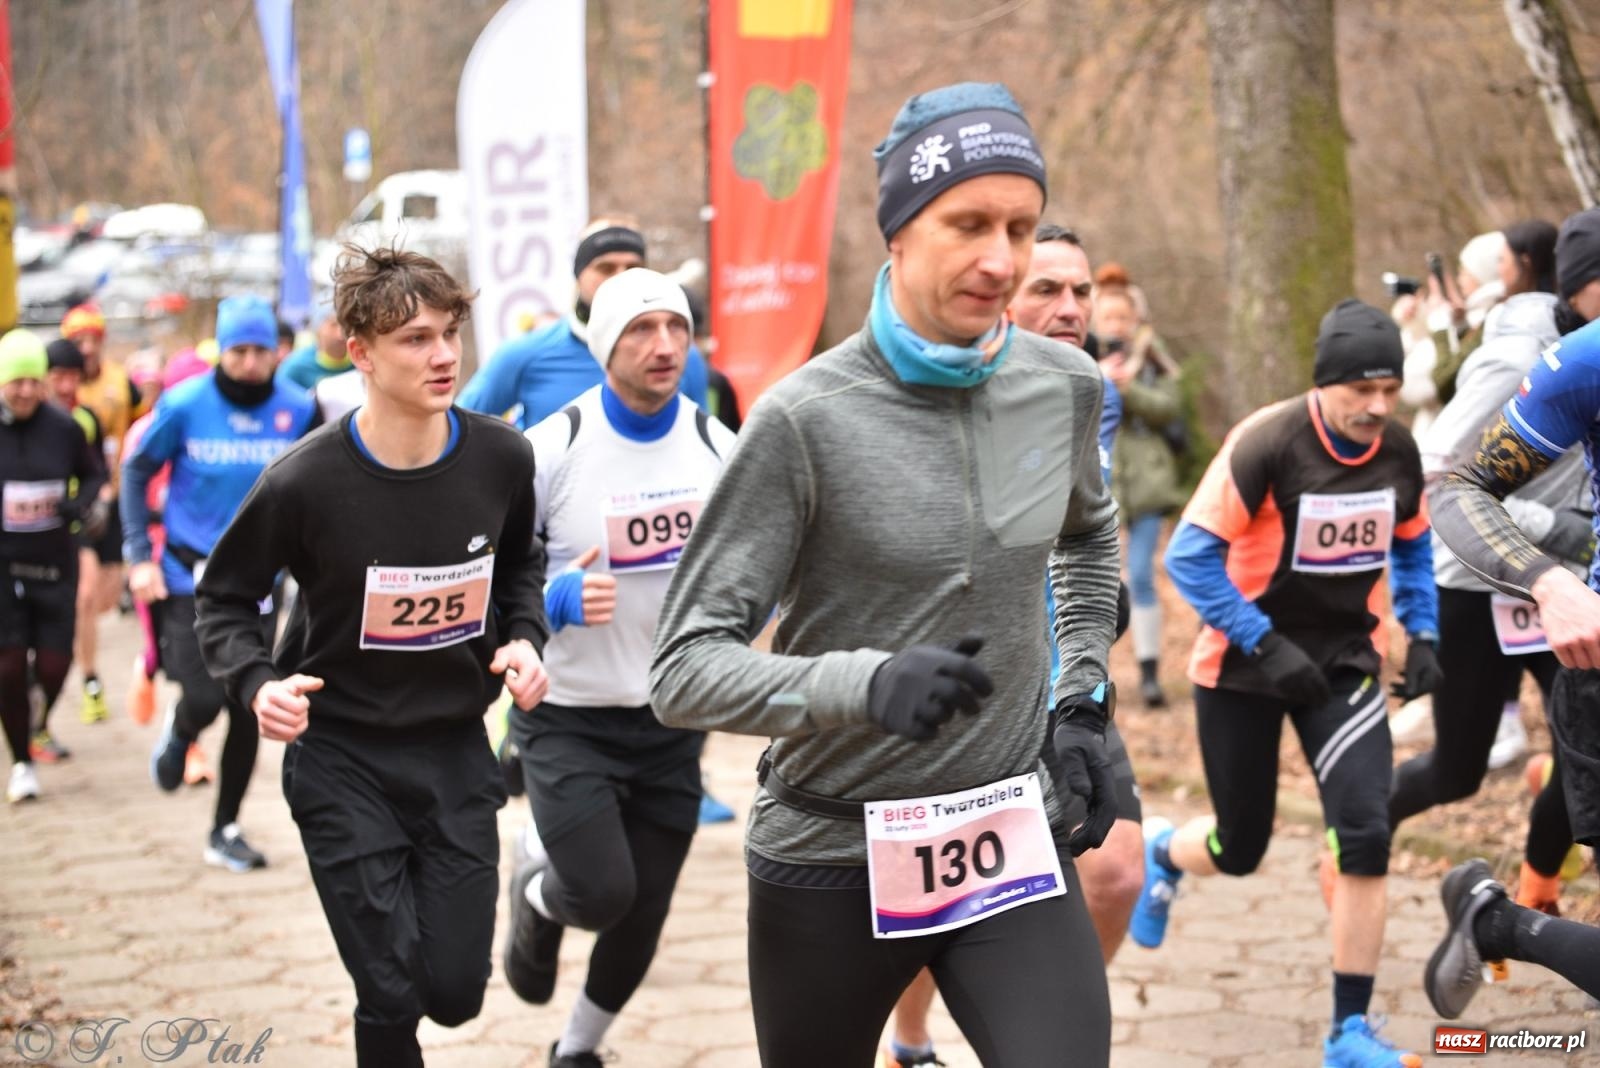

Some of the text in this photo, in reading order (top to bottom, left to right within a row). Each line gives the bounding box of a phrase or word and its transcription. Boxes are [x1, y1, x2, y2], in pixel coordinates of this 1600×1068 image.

[627, 511, 692, 547] 099
[1317, 519, 1377, 548] 048
[414, 565, 483, 582] Twardziela
[391, 592, 466, 627] 225
[883, 785, 1024, 822] BIEG Twardziela
[914, 830, 1006, 894] 130
